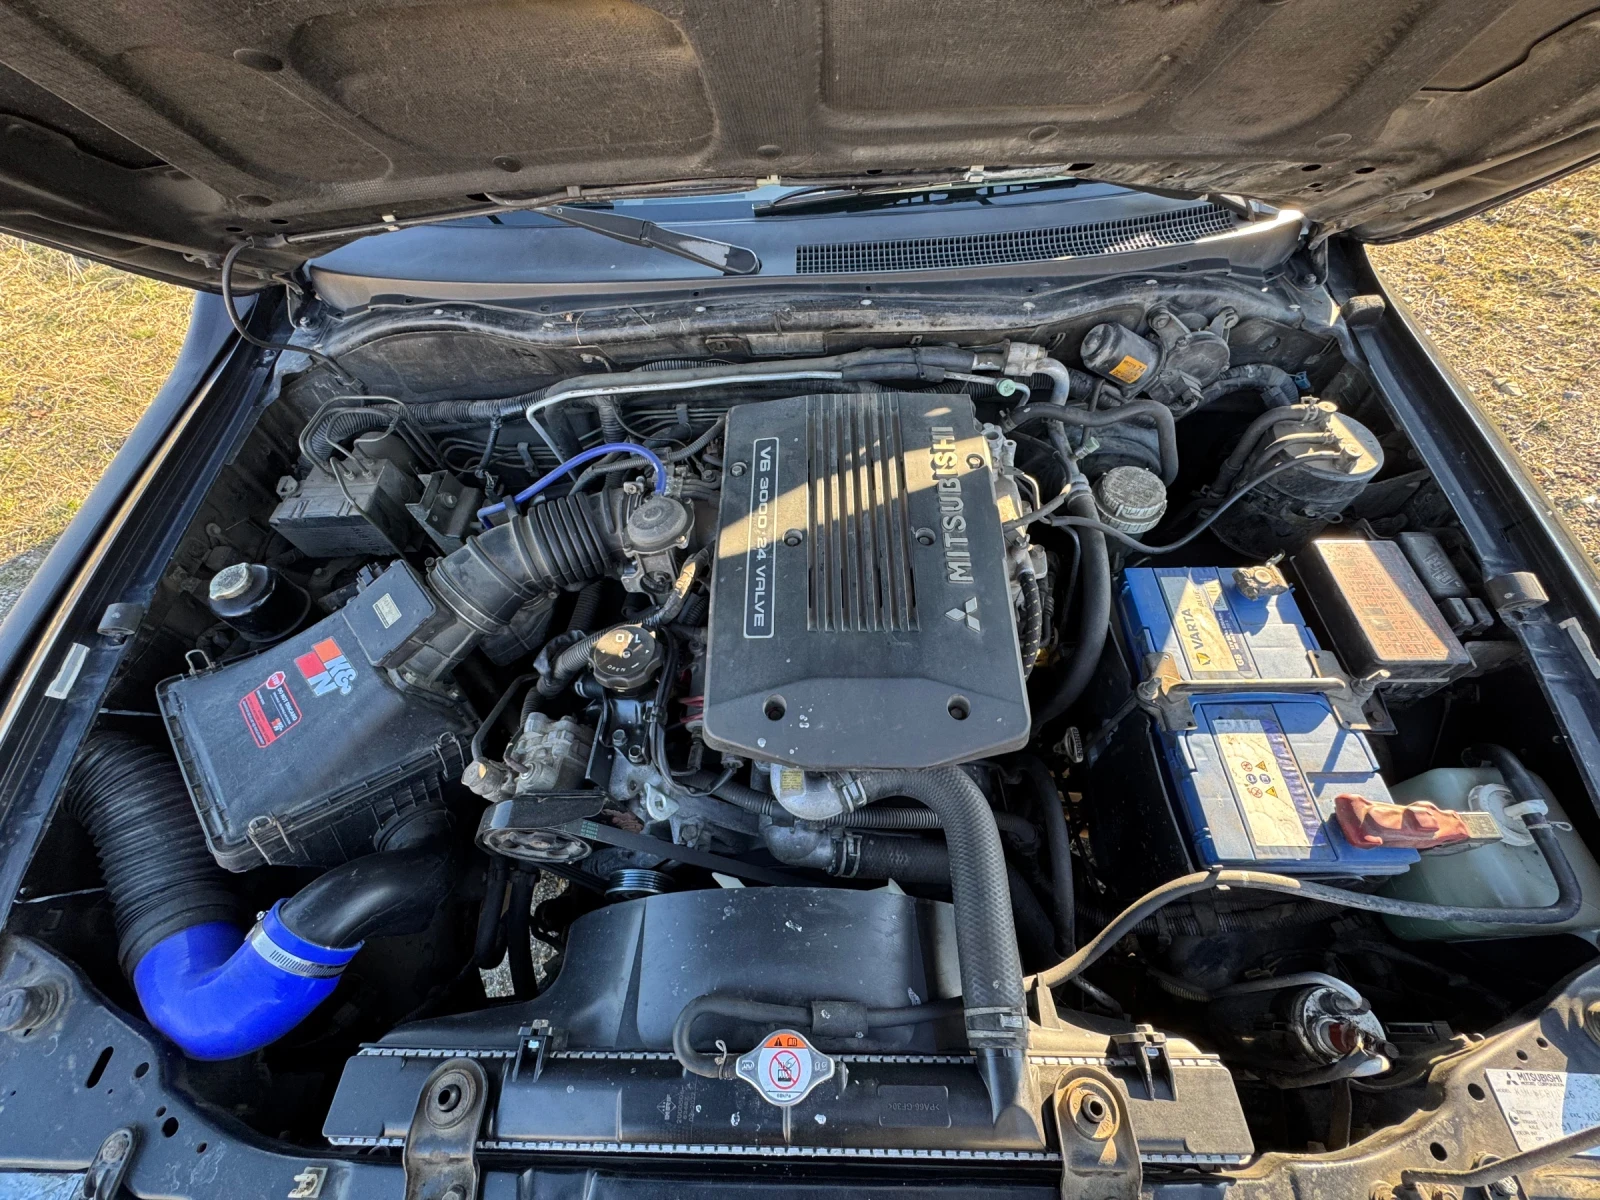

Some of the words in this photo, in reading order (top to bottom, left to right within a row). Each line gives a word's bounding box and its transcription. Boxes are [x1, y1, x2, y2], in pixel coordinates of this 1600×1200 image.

[759, 446, 771, 472] V6
[932, 427, 973, 584] MITSUBISHI
[753, 565, 766, 627] VALVE
[1181, 608, 1204, 650] VARTA
[307, 655, 357, 697] K&N
[607, 664, 626, 672] OPEN
[1234, 653, 1245, 667] G8
[1517, 1072, 1562, 1083] MITSUBISHI
